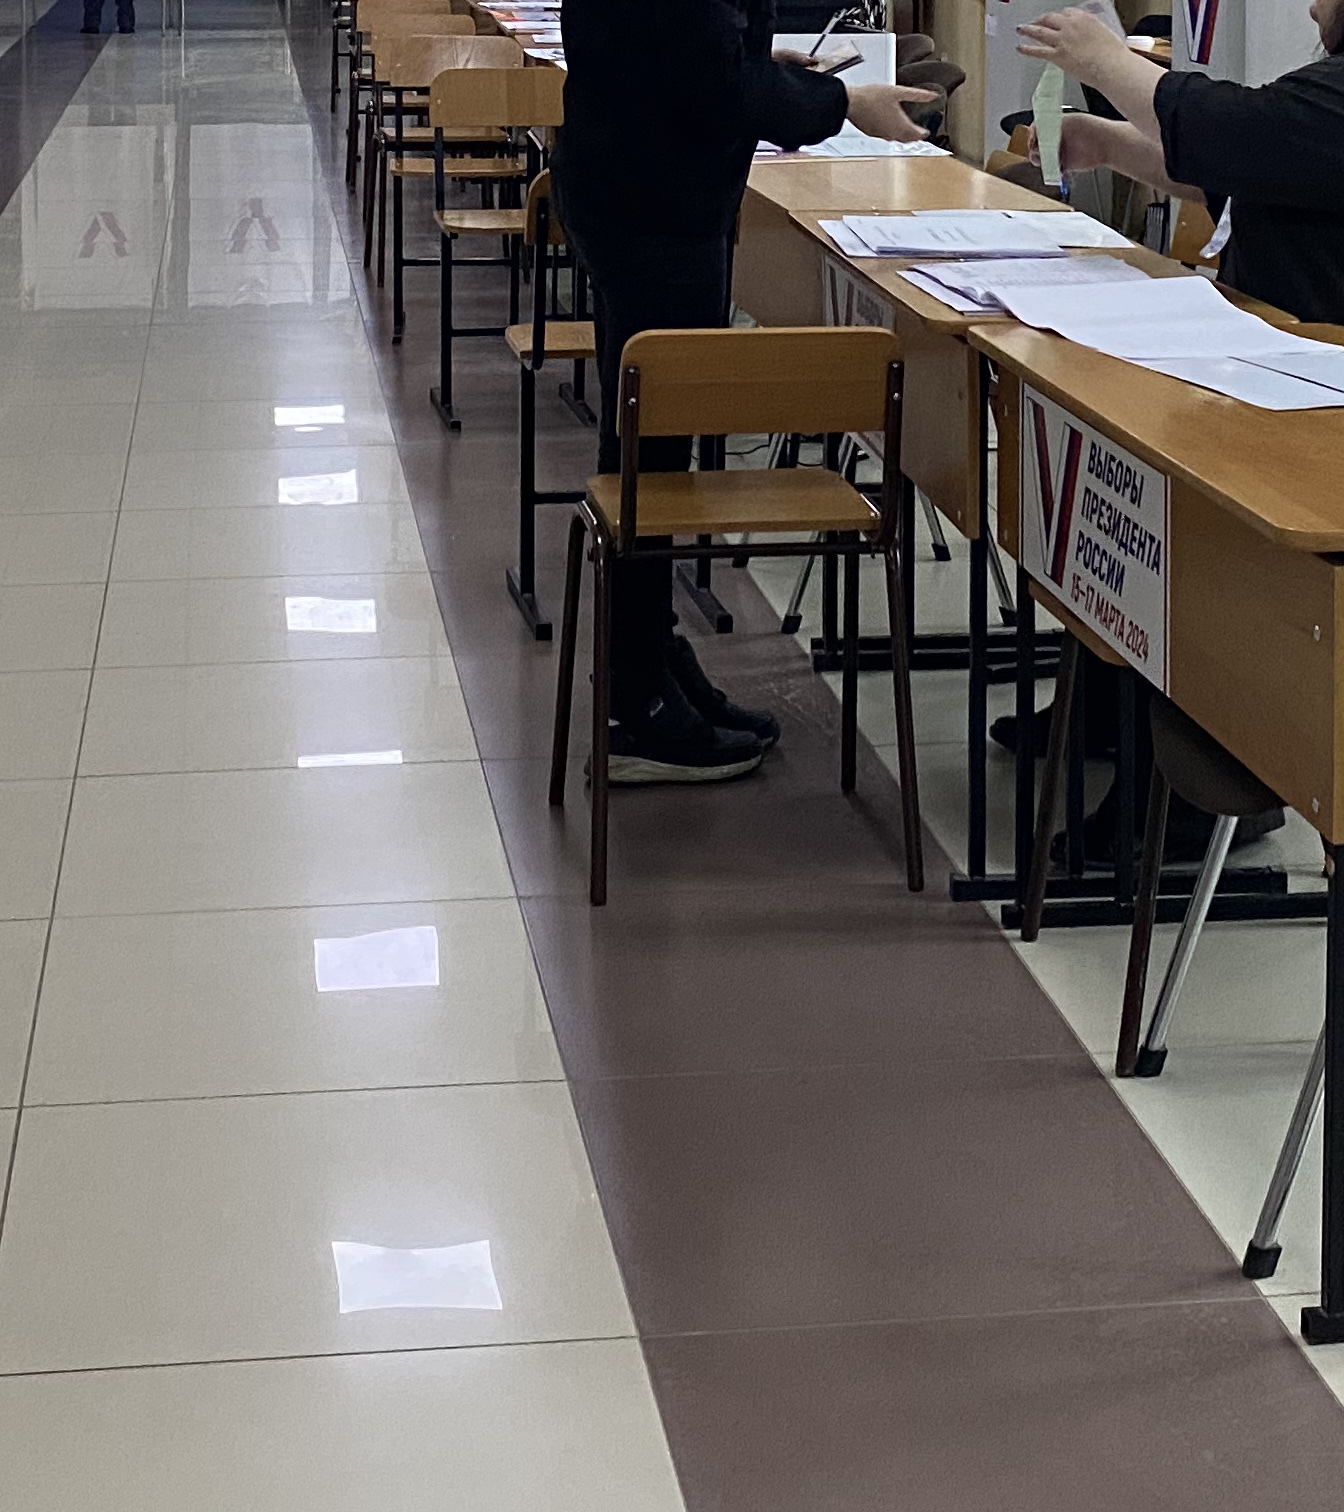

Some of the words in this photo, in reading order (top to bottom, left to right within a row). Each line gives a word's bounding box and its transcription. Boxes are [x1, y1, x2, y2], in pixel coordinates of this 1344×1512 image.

[1087, 439, 1144, 509] ВЫБОРЫ
[1075, 529, 1126, 597] РОССИИ
[1081, 486, 1161, 576] ПРЕЗИДЕНТА
[1094, 592, 1125, 643] МАРТА
[1126, 619, 1149, 664] 2024
